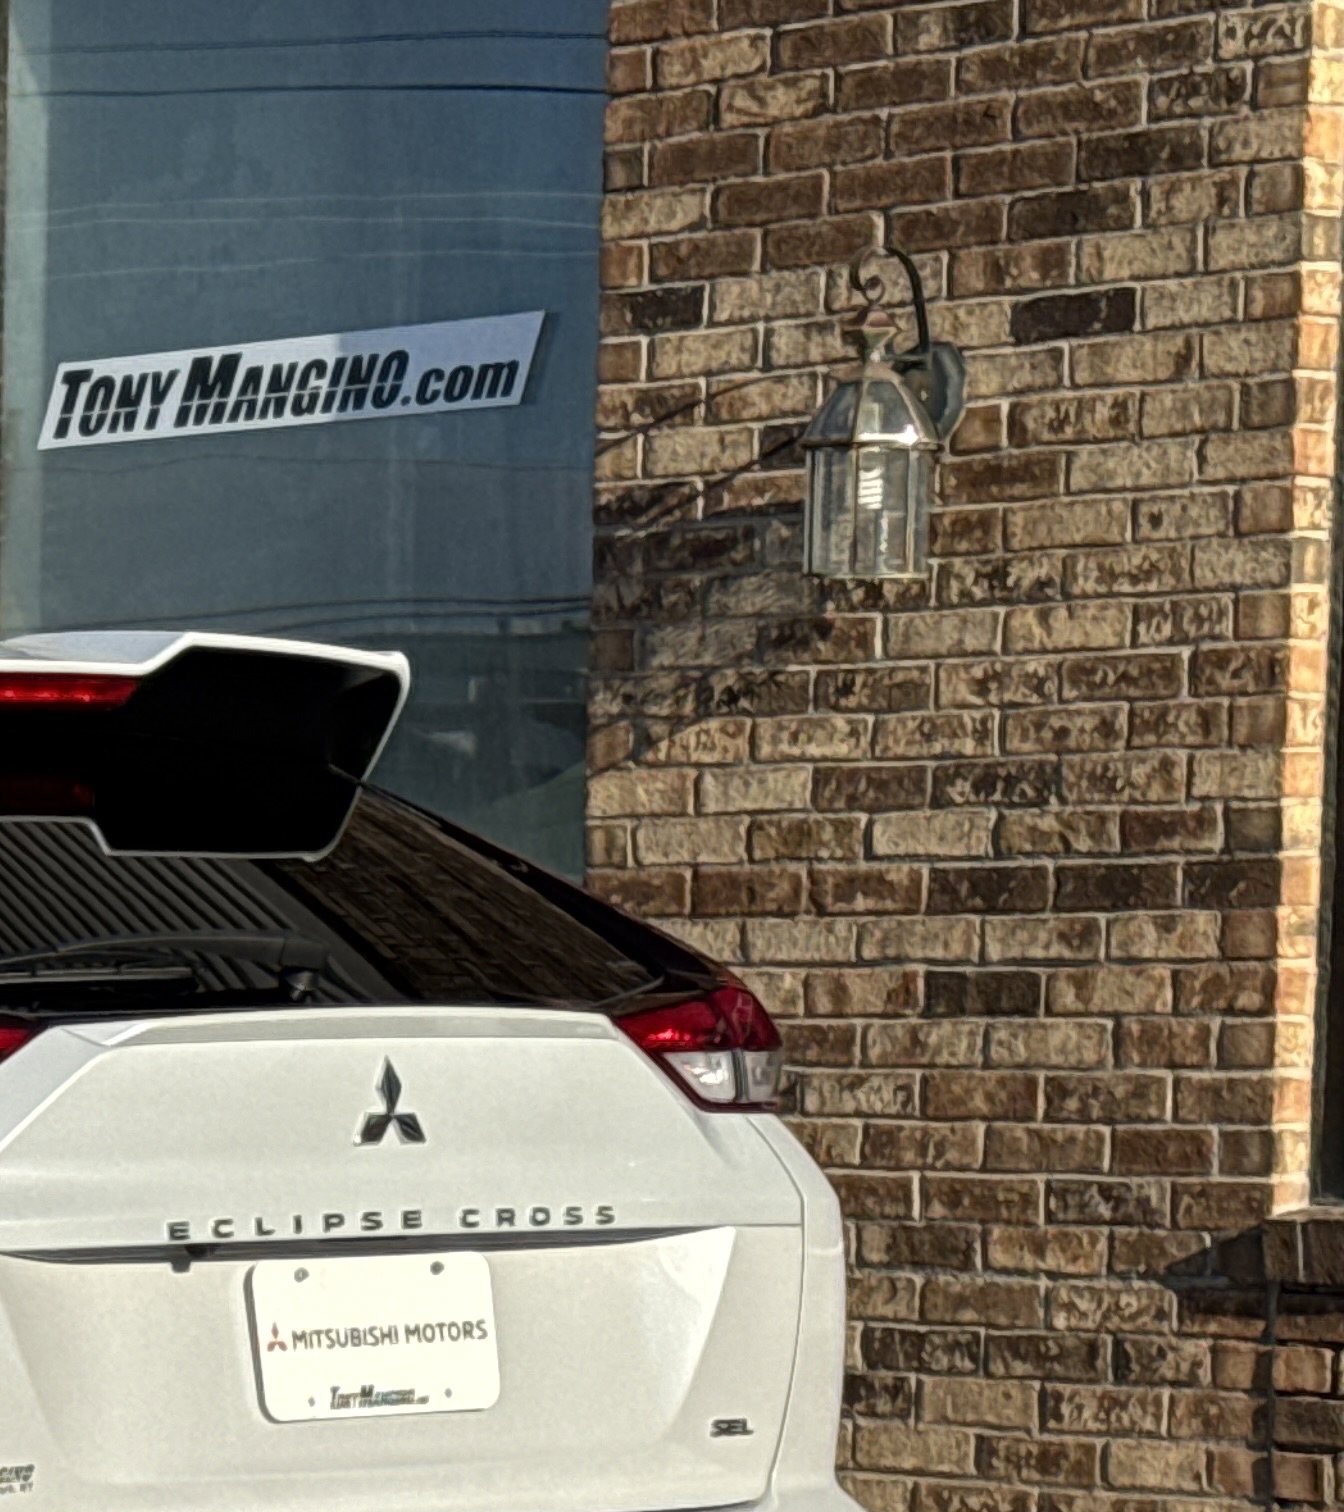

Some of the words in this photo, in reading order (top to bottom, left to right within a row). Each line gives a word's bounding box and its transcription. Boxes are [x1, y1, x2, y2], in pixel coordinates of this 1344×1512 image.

[166, 1208, 424, 1241] ECLIPSE
[459, 1205, 617, 1228] CROSS
[291, 1323, 400, 1351] MITSUBISHI
[404, 1319, 489, 1344] MOTORS
